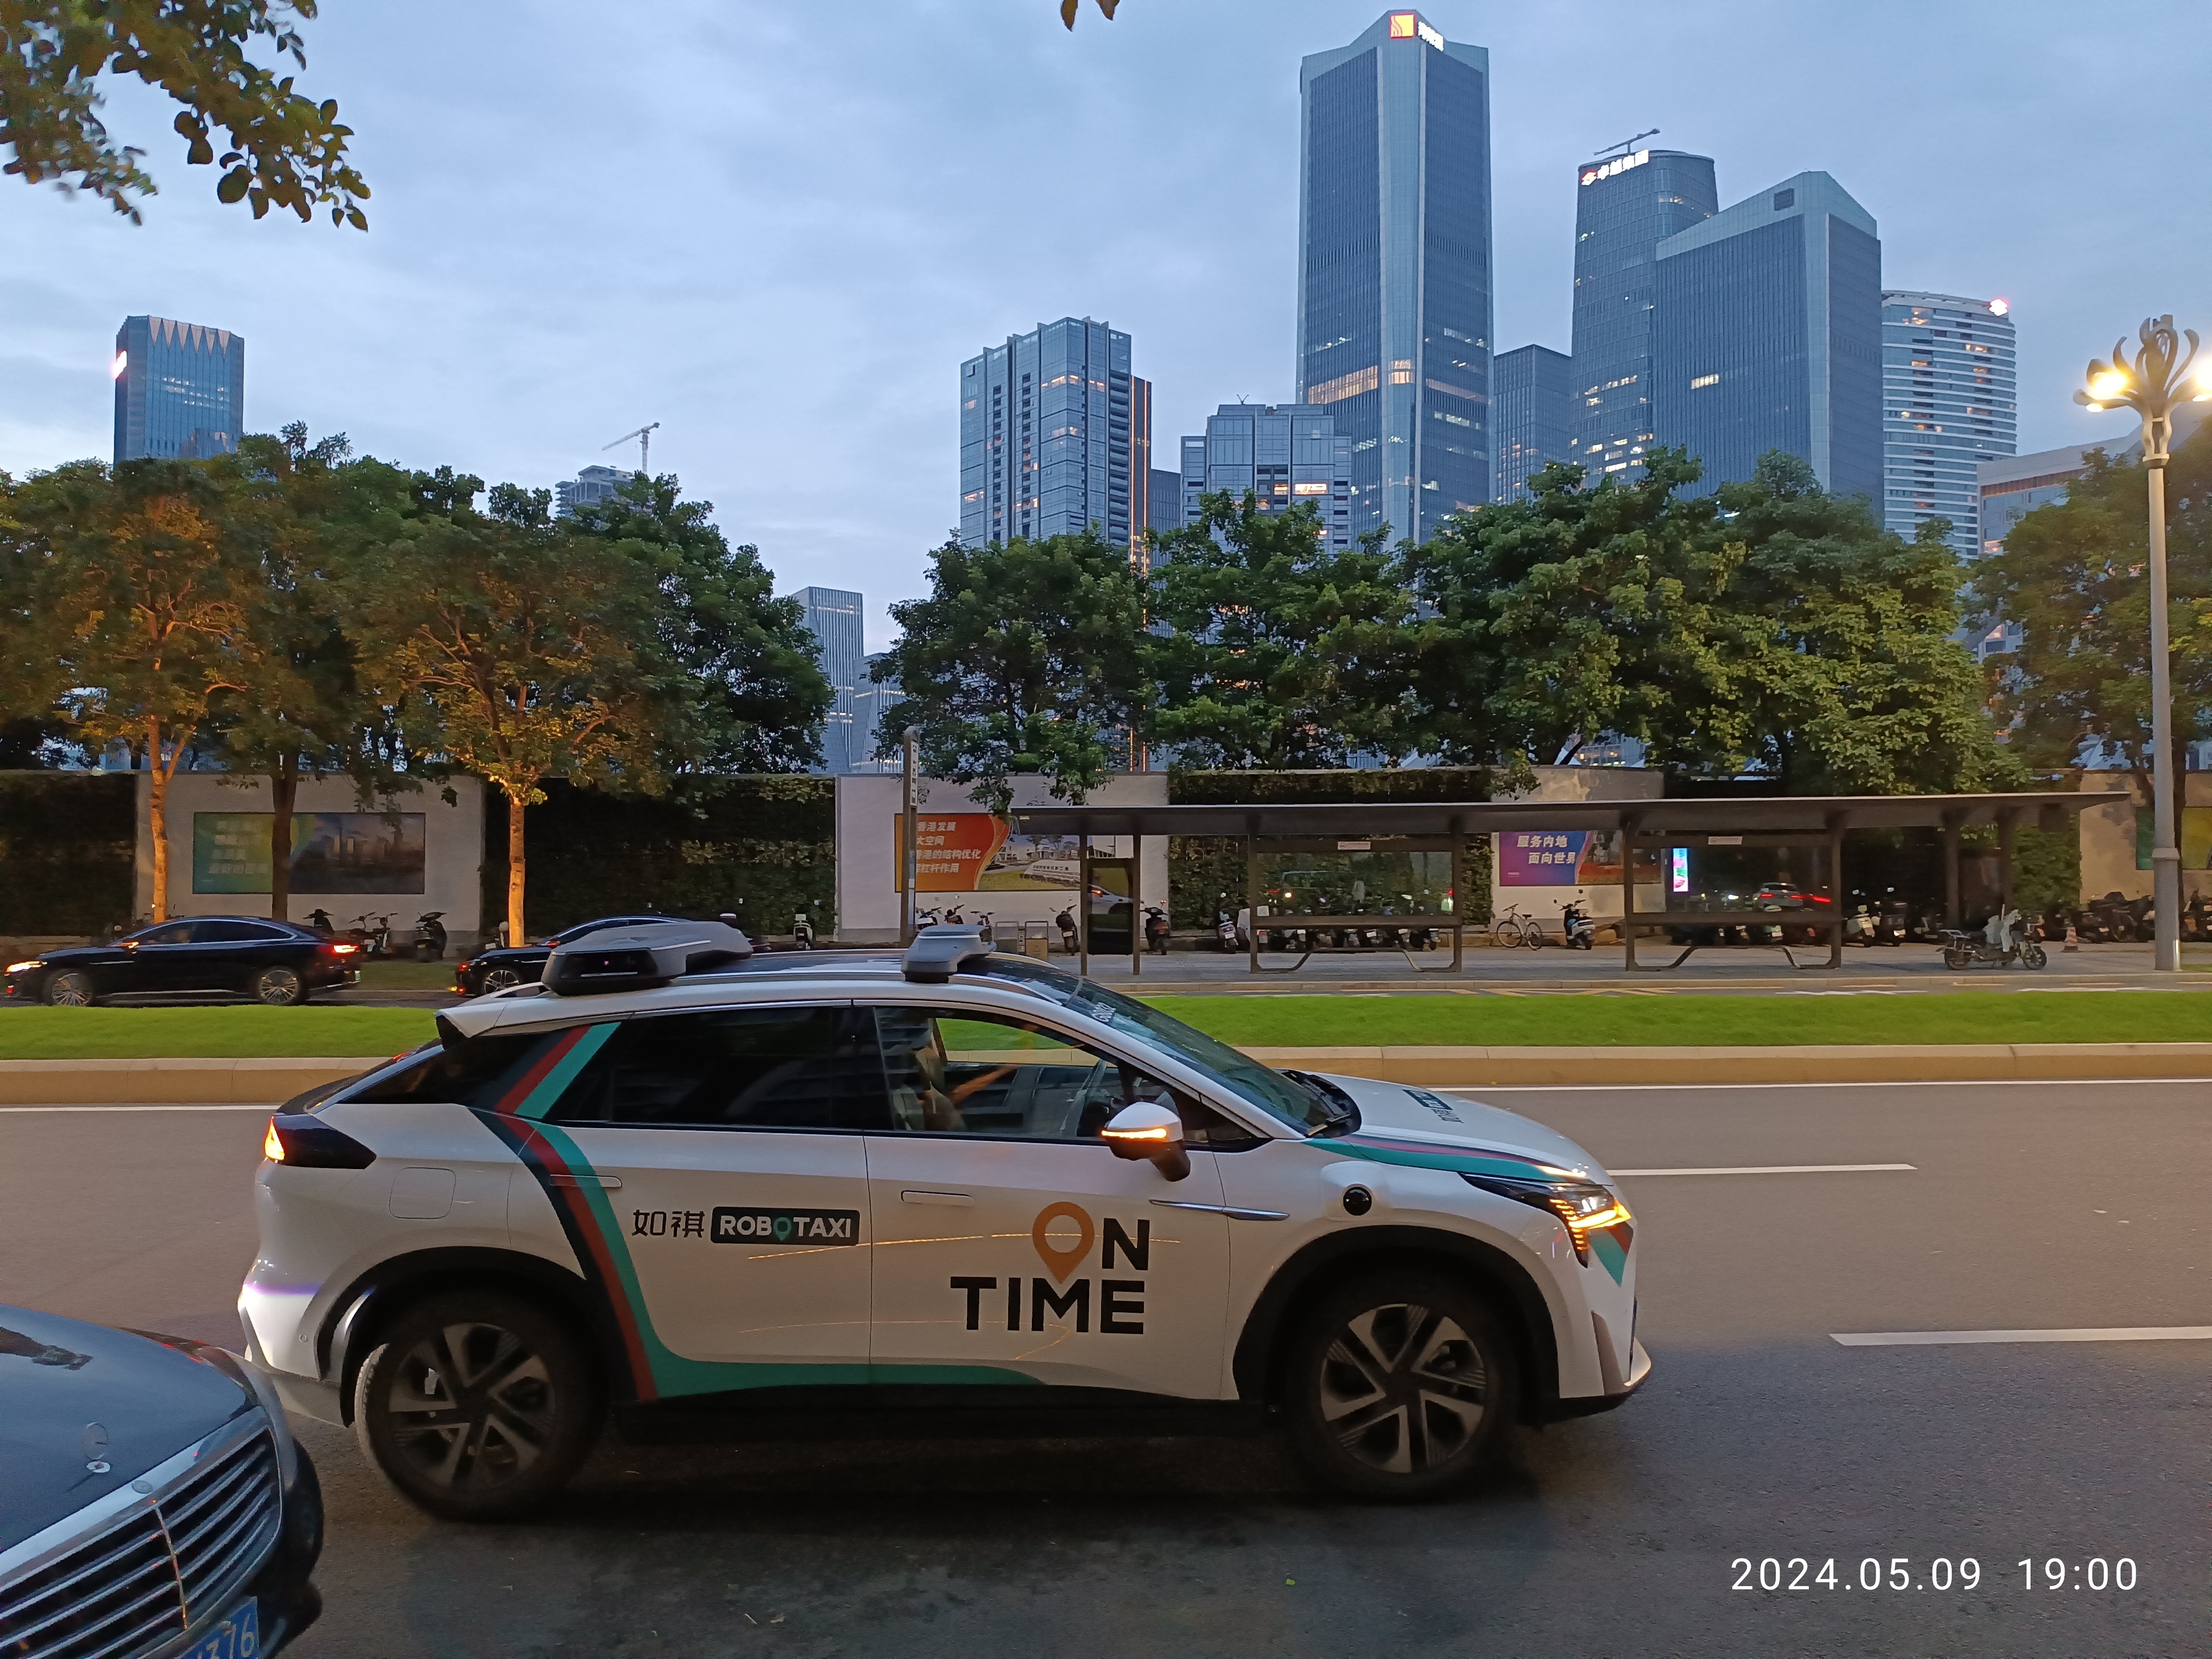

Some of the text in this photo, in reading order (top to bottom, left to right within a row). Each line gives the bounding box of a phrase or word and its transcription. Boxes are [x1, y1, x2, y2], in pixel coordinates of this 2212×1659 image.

[1517, 835, 1568, 848] 服务内地
[1528, 852, 1576, 864] 面向世界
[1092, 1002, 1116, 1022] G8032
[631, 1209, 851, 1242] 如祺 ROBOTAXI
[1032, 1201, 1150, 1284] ON
[950, 1276, 1145, 1334] TIME
